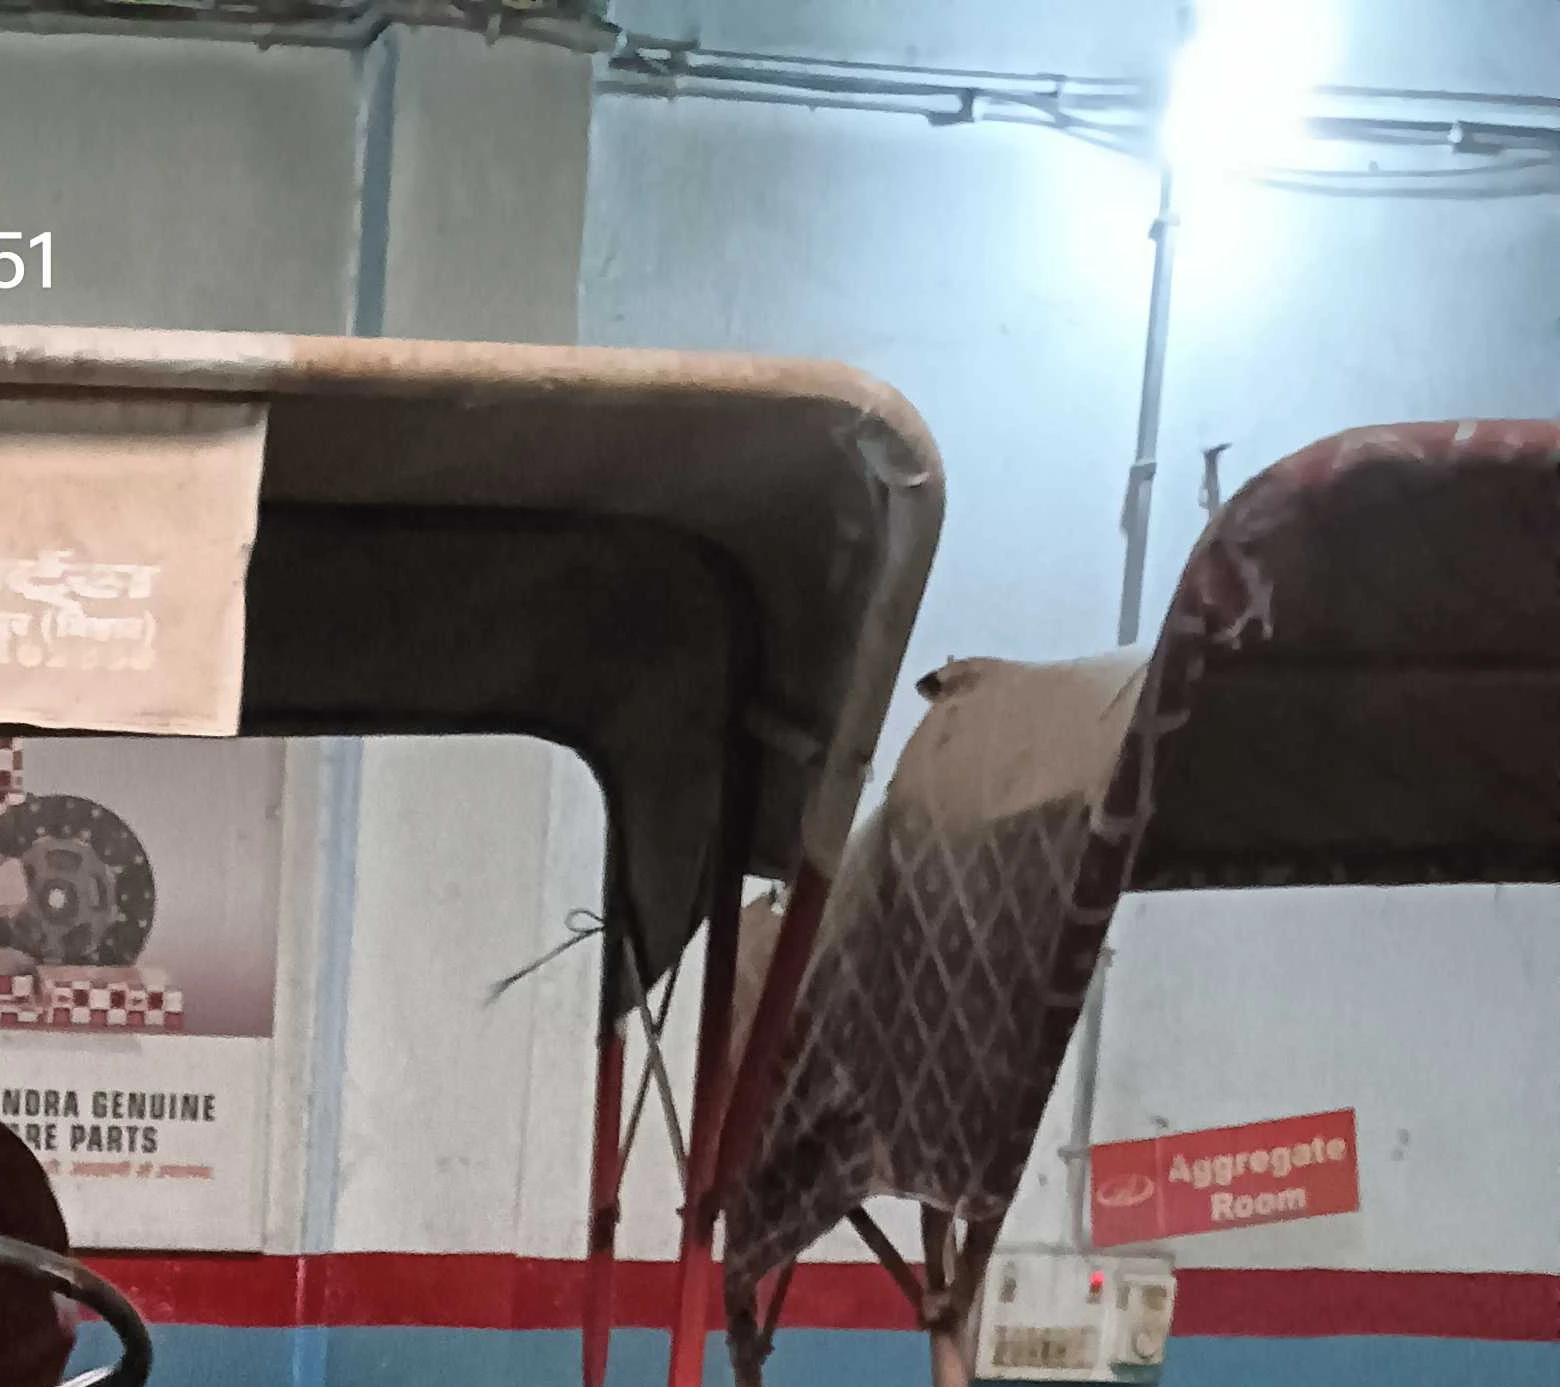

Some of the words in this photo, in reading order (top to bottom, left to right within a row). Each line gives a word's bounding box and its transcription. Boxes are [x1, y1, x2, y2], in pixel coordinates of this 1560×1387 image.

[91, 1090, 216, 1122] GENUINE
[70, 1124, 158, 1153] PARTS
[1168, 1135, 1348, 1189] Aggregate
[1209, 1184, 1308, 1222] Room
